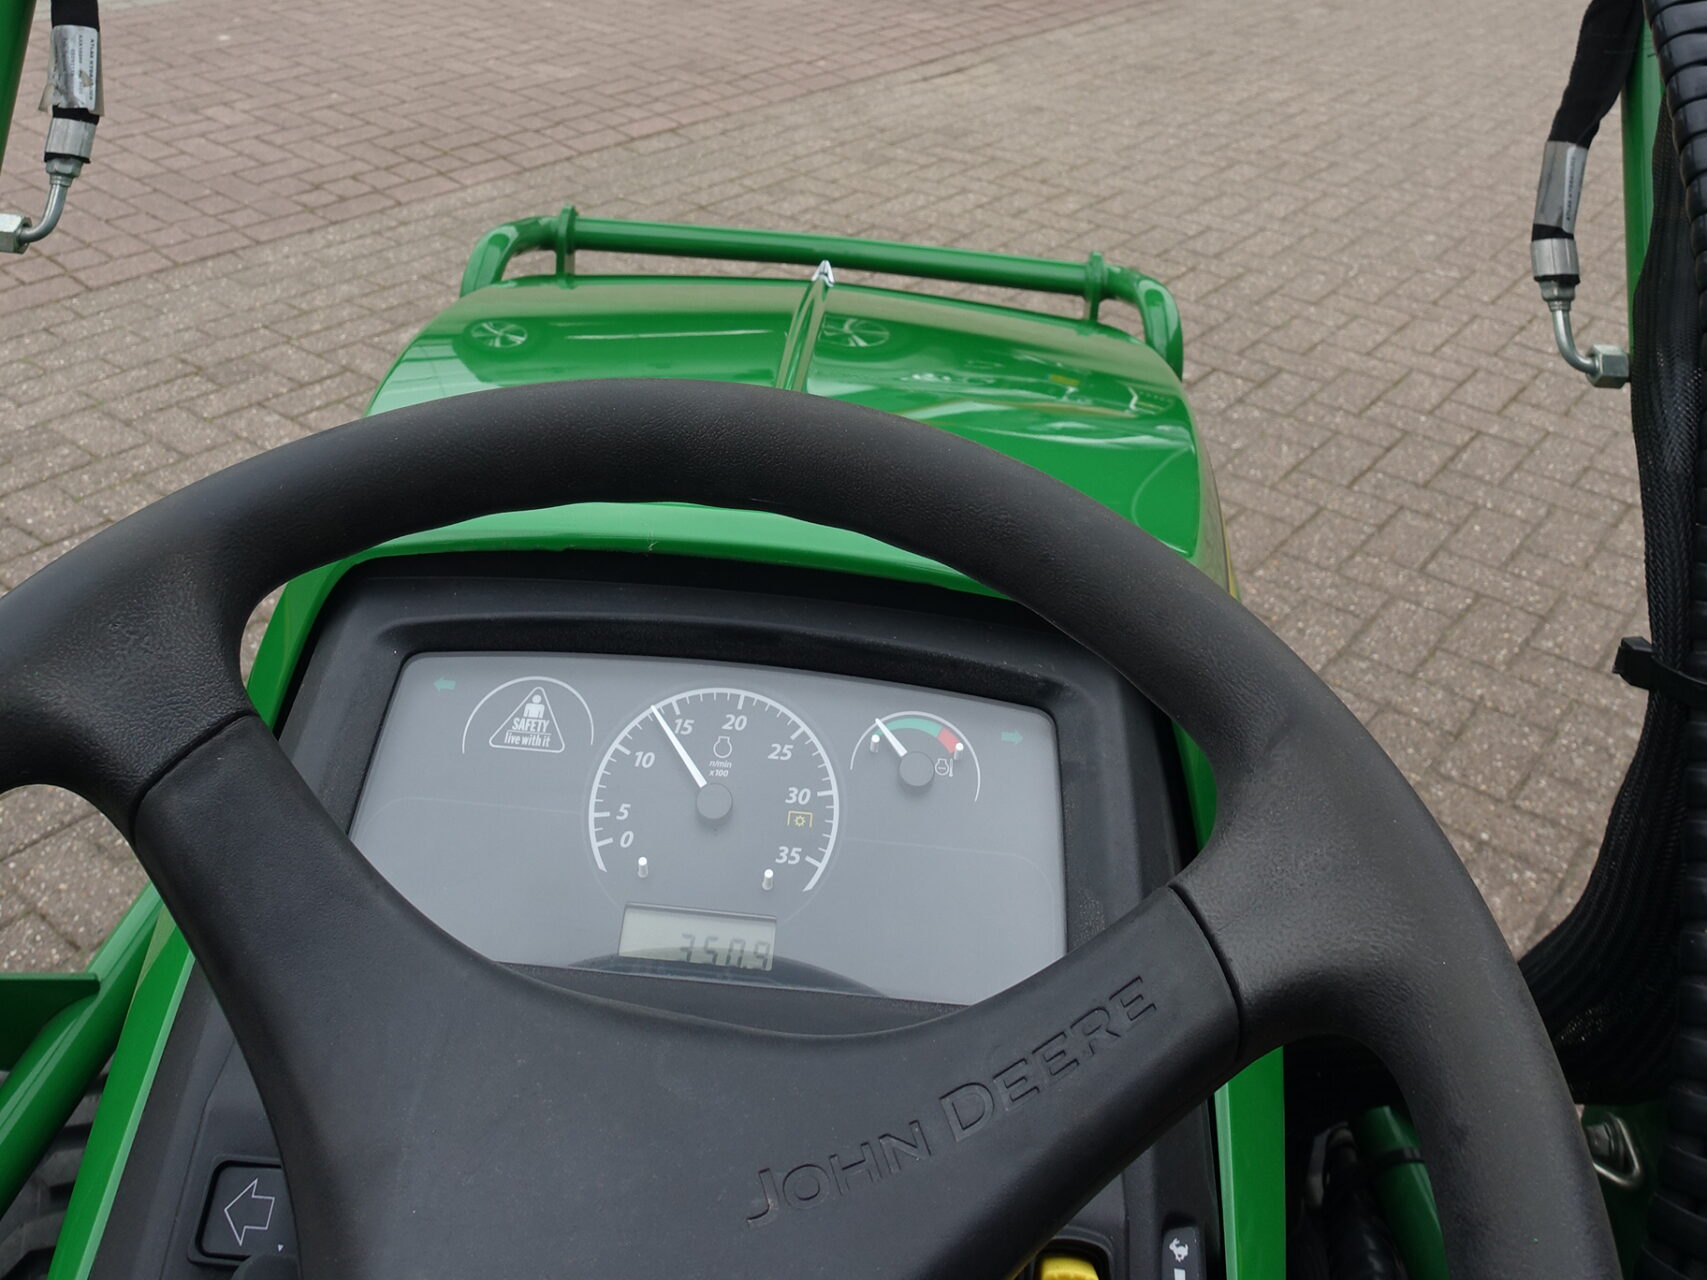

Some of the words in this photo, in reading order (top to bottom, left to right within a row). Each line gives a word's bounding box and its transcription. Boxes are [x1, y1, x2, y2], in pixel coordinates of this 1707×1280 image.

[512, 718, 549, 732] SAFETY
[673, 718, 695, 735] 15
[721, 714, 748, 731] 20
[504, 731, 520, 744] live
[522, 733, 540, 746] with
[542, 736, 551, 747] it
[634, 751, 656, 769] 10
[767, 743, 794, 761] 25
[708, 769, 729, 777] x100
[784, 786, 811, 805] 30
[616, 803, 631, 820] 5
[619, 830, 634, 848] 0
[775, 846, 802, 865] 35
[746, 1120, 932, 1227] JOHN
[939, 975, 1157, 1142] DEERE
